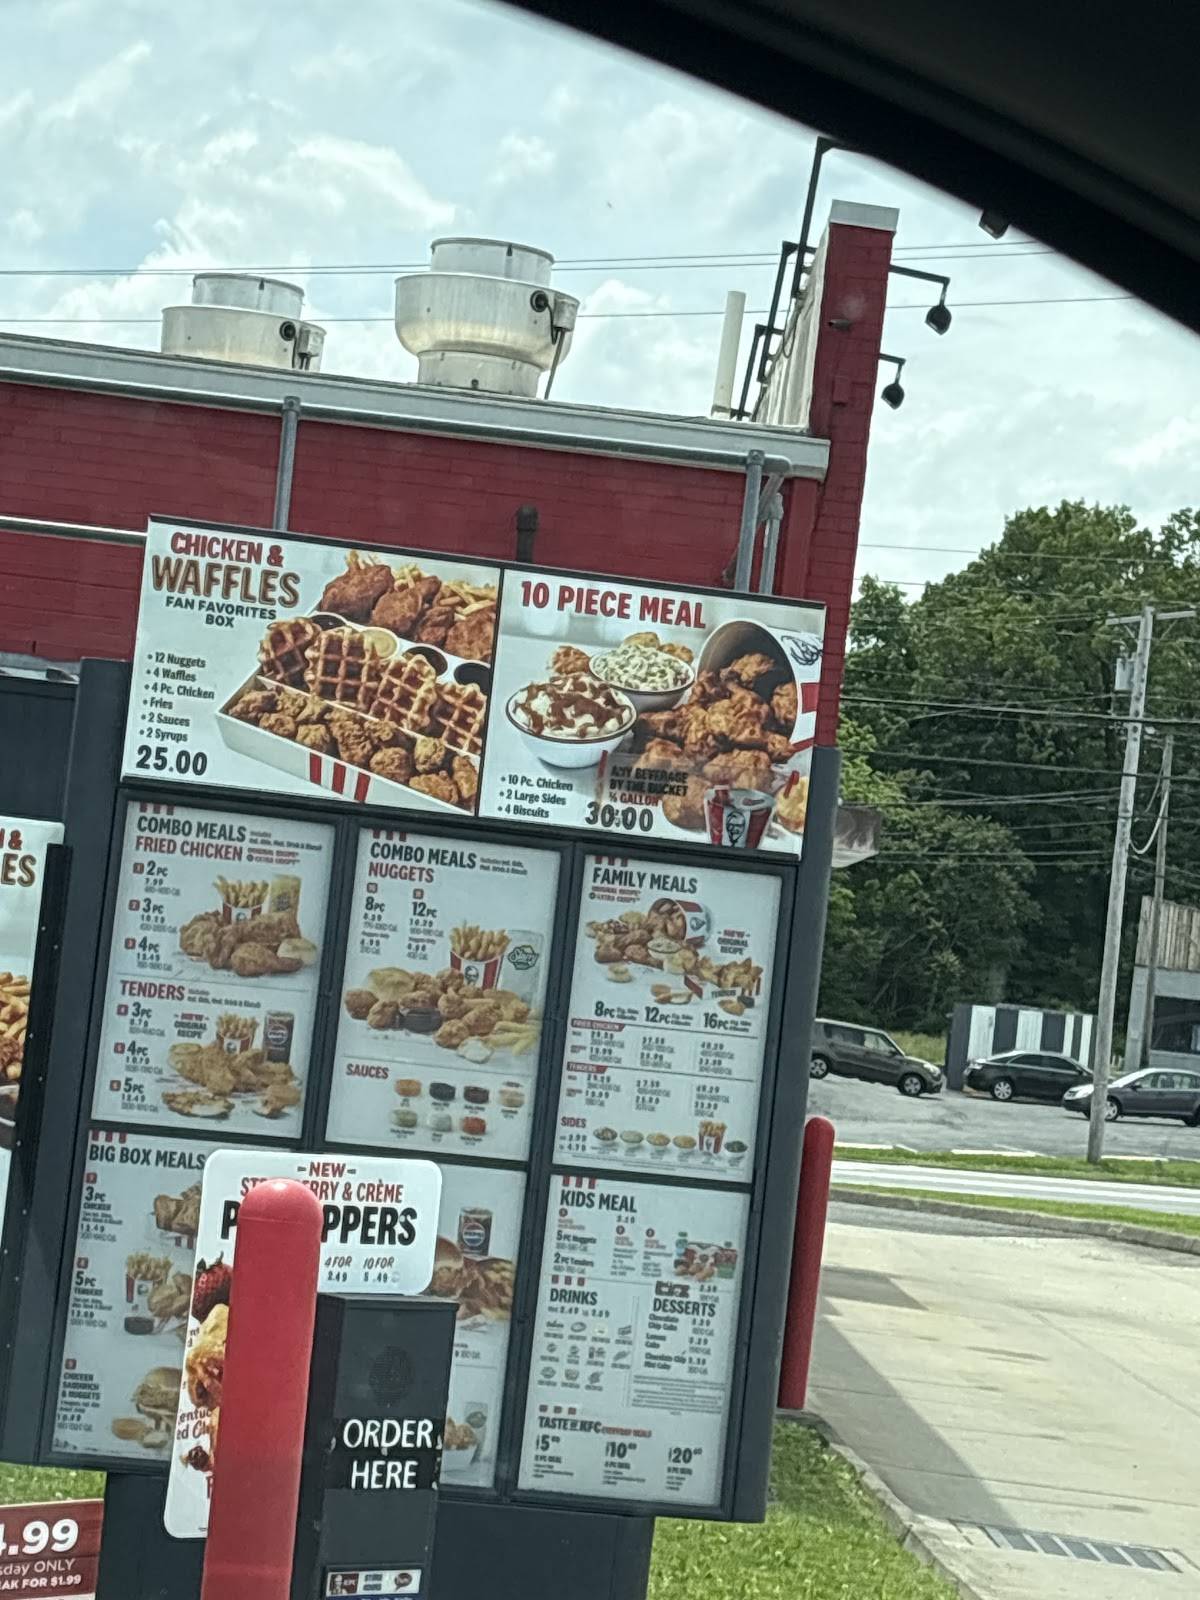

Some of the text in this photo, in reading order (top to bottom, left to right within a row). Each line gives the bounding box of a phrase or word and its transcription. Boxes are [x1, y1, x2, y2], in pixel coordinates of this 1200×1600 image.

[171, 532, 284, 567] CHICKEN &
[151, 555, 300, 608] WAFFLES
[165, 596, 277, 620] FAN FAVORITES
[521, 581, 707, 629] 10 PIECE MEAL
[205, 613, 235, 628] BOX
[154, 652, 207, 669] 12 Nuggets
[153, 668, 196, 682] 4 Waffles
[151, 682, 158, 693] 4
[176, 685, 215, 699] Chicken
[150, 697, 173, 710] Fries
[148, 712, 190, 728] 2 Sauces
[146, 727, 188, 743] 2 Syrups
[135, 745, 208, 776] 25.00
[508, 775, 518, 786] 10
[536, 778, 573, 792] Chicken
[513, 791, 539, 806] Large
[542, 794, 567, 806] Sides
[513, 805, 549, 819] Biscuits
[137, 816, 192, 837] COMBO
[196, 822, 247, 843] MEALS
[8, 830, 23, 850] &
[135, 836, 177, 854] FRIED
[180, 841, 243, 862] CHICKEN
[370, 842, 424, 863] COMBO
[427, 848, 477, 869] MEALS
[368, 862, 434, 883] NUGGETS
[592, 867, 698, 894] FAMILY MEALS
[120, 980, 186, 1001] TENDERS
[346, 1063, 389, 1080] SAUCES
[561, 1117, 587, 1128] SIDES
[89, 1144, 206, 1170] BIG BOX MEALS
[309, 1162, 346, 1177] NEW
[342, 1183, 353, 1201] &
[356, 1179, 404, 1204] CRÈME
[560, 1190, 638, 1213] KIDS MEAL
[550, 1288, 598, 1306] DRINKS
[653, 1298, 716, 1318] DESSERTS
[343, 1418, 434, 1448] ORDER
[538, 1416, 569, 1431] TASTE
[579, 1420, 602, 1434] KFC
[351, 1460, 419, 1490] HERE
[34, 1558, 76, 1574] ONLY
[22, 1577, 48, 1589] FOR
[50, 1574, 82, 1588] $1.99
